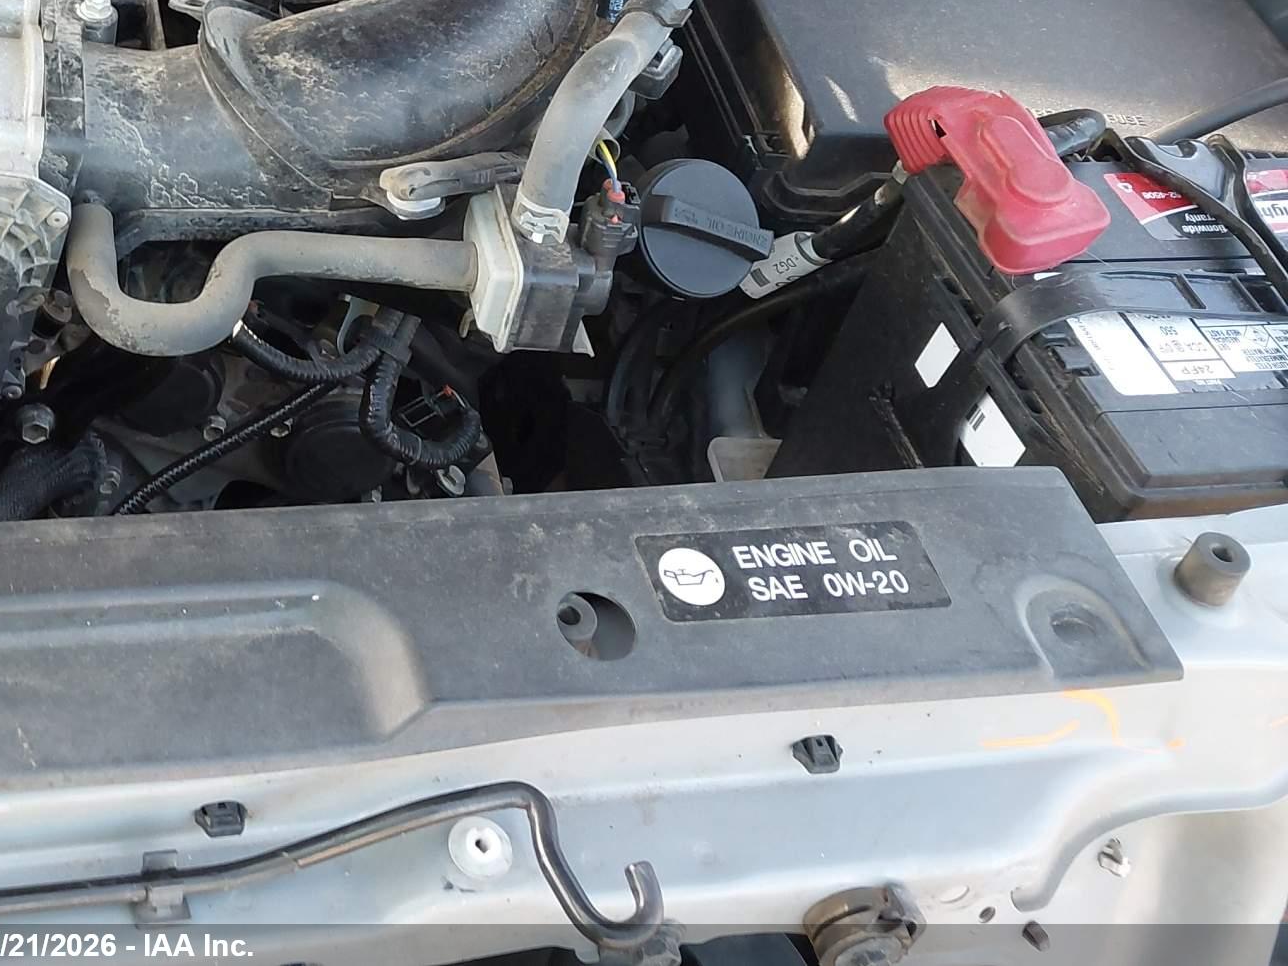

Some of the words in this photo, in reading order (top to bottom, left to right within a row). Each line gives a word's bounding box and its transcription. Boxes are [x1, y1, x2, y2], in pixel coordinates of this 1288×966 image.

[1181, 224, 1228, 235] tionwide
[732, 541, 837, 569] ENGINE
[848, 538, 898, 563] OIL
[748, 575, 808, 601] SAE
[823, 570, 910, 597] 0W-20
